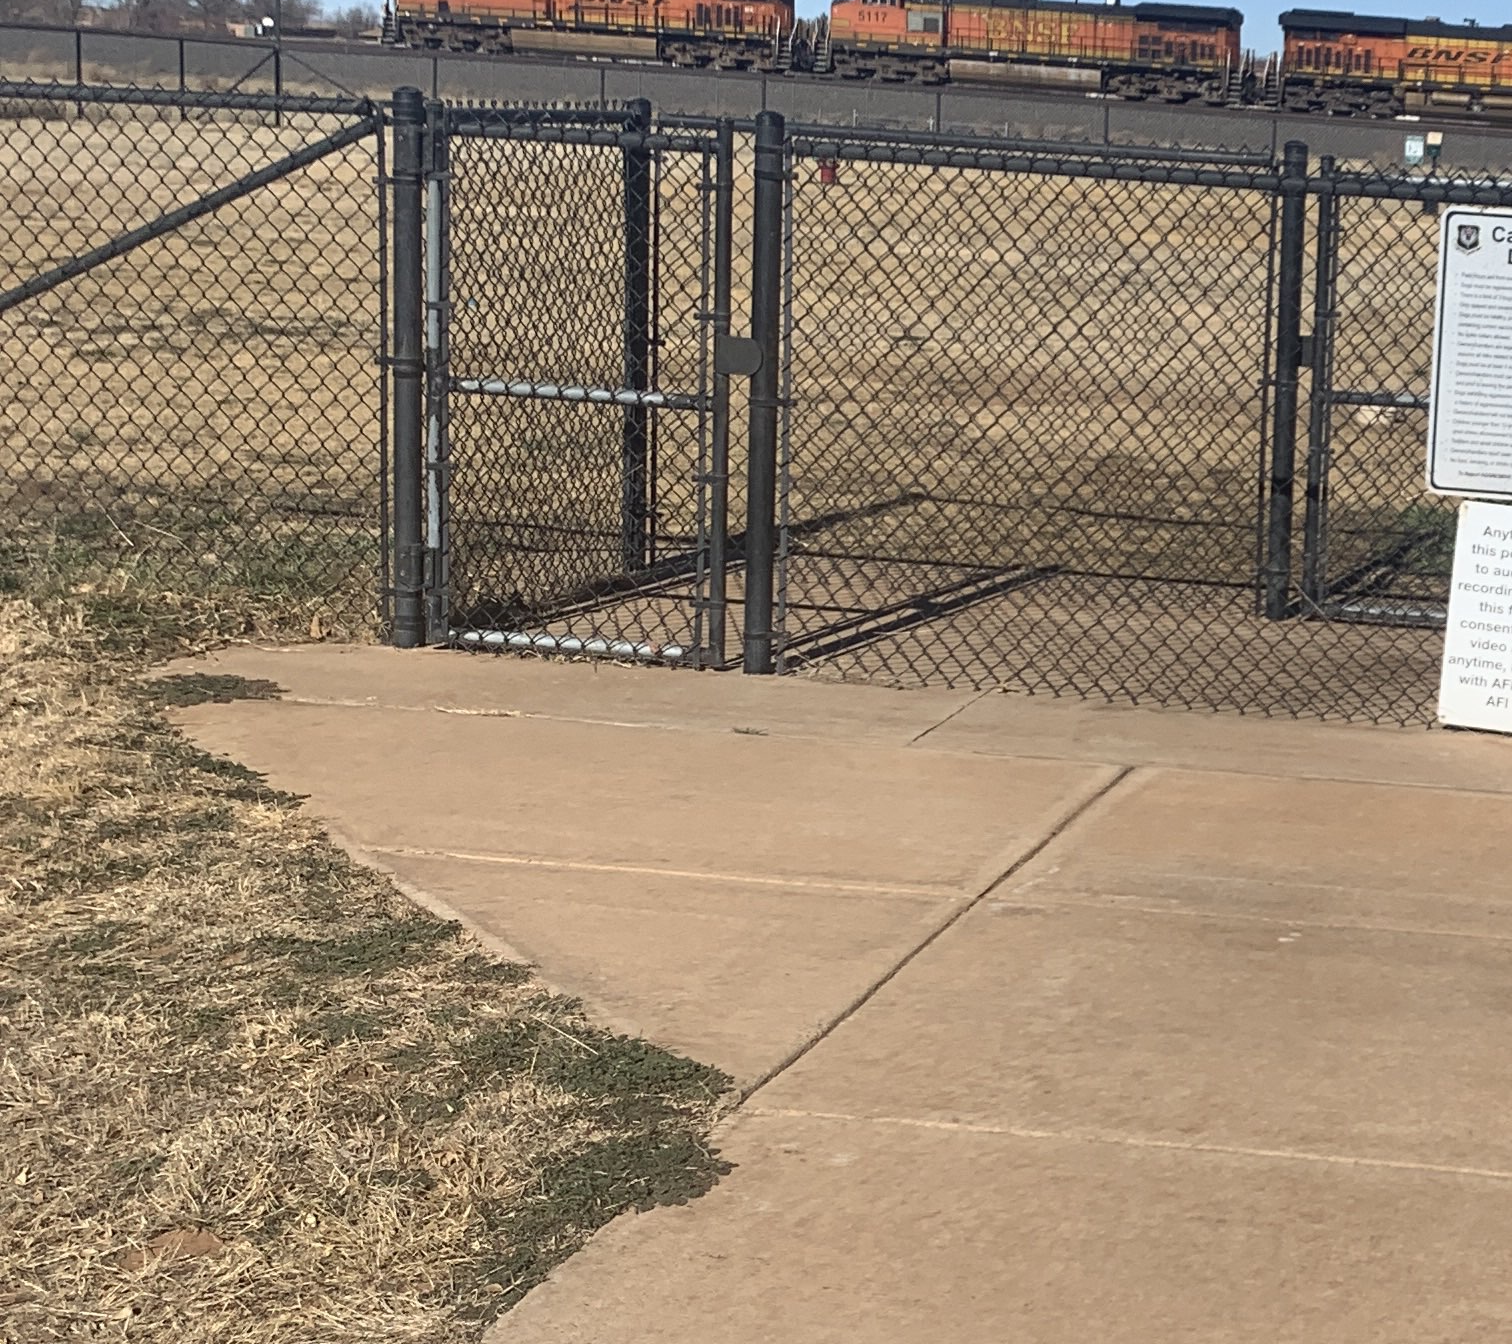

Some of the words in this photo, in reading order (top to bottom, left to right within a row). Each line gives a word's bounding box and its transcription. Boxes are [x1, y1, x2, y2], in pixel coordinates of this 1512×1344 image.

[858, 10, 888, 23] 5117
[988, 20, 1079, 45] BNSF
[1472, 544, 1496, 557] this
[1476, 564, 1489, 574] to
[1479, 601, 1504, 615] this
[1470, 638, 1507, 652] video
[1449, 655, 1506, 673] anytime,
[1459, 673, 1487, 687] with
[1486, 696, 1508, 709] AFI
